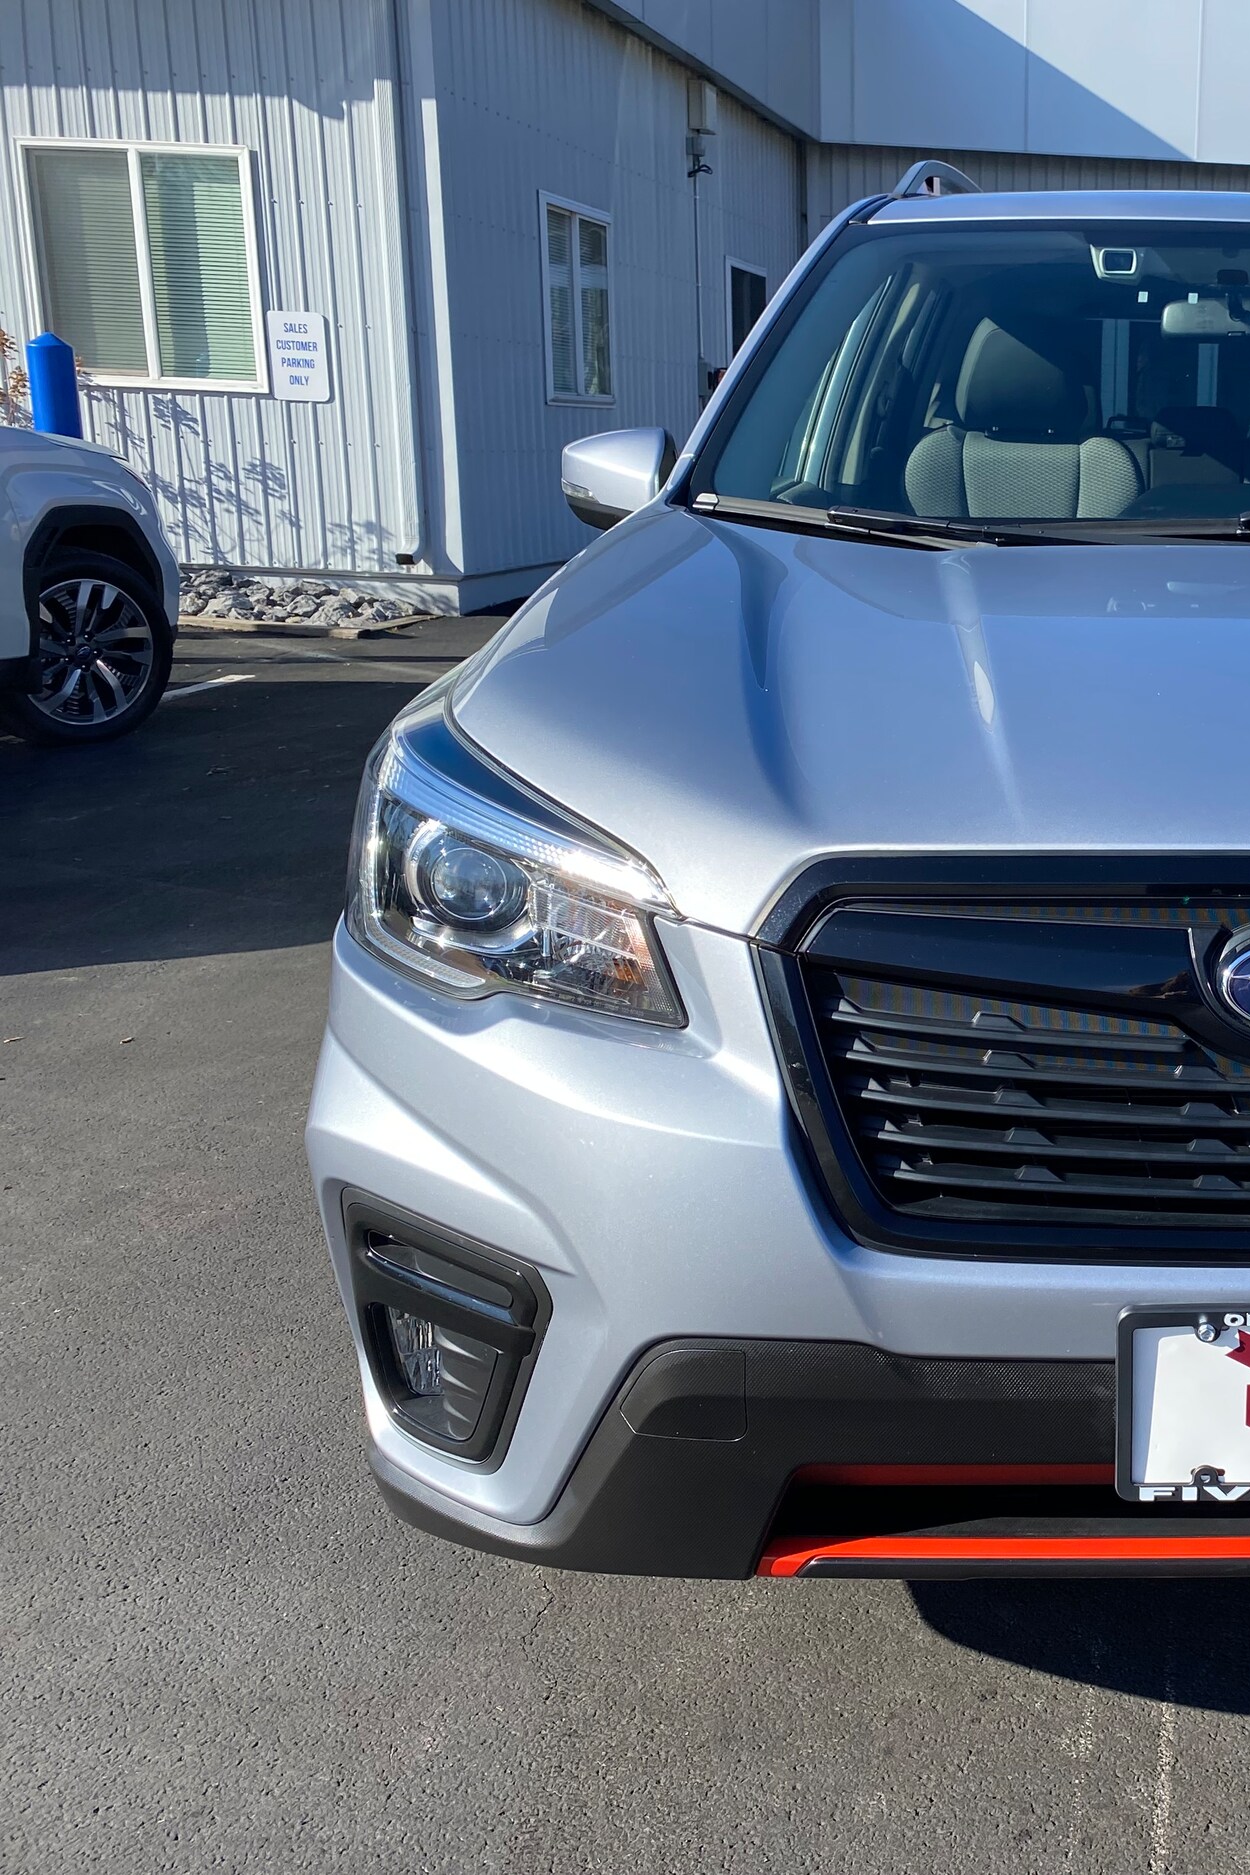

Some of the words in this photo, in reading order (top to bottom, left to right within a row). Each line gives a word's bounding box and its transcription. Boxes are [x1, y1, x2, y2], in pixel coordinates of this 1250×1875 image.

[283, 323, 308, 333] SALES
[276, 340, 317, 351] CUSTOMER
[281, 357, 315, 368] PARKING
[289, 375, 309, 385] ONLY
